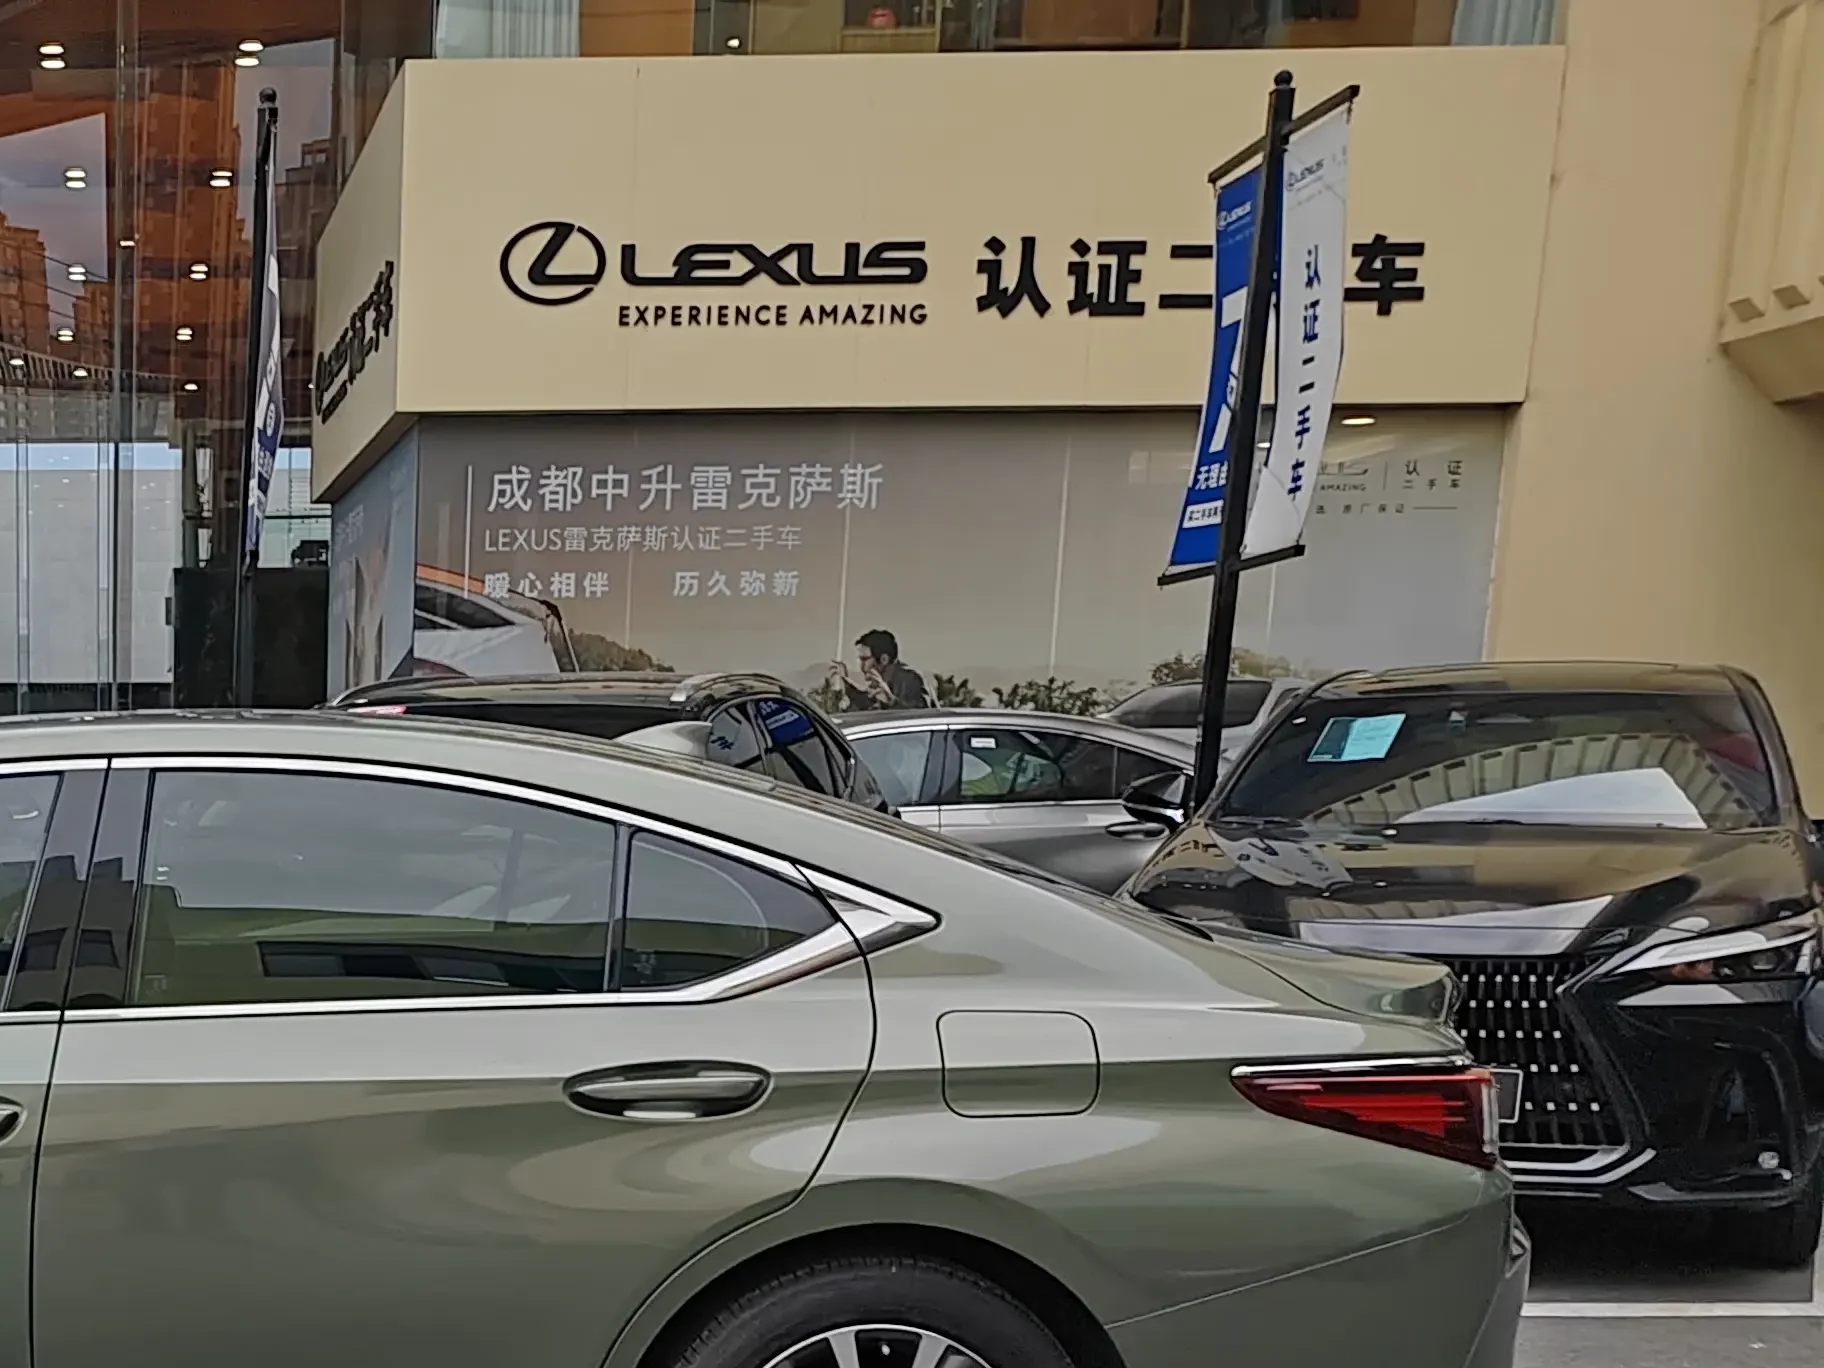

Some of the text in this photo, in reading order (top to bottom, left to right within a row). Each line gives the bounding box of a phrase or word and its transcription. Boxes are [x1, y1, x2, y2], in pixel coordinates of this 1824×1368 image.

[620, 241, 928, 286] LEXUS
[976, 233, 1425, 318] 认证二车
[619, 303, 928, 327] EXPERIENCE AMAZING
[1288, 244, 1321, 502] 认证二手车
[487, 463, 884, 513] 成都中升雷克萨斯
[484, 524, 802, 553] LEXUS雷克萨斯认证二手车
[484, 570, 801, 599] 暖心相伴 历久弥新
